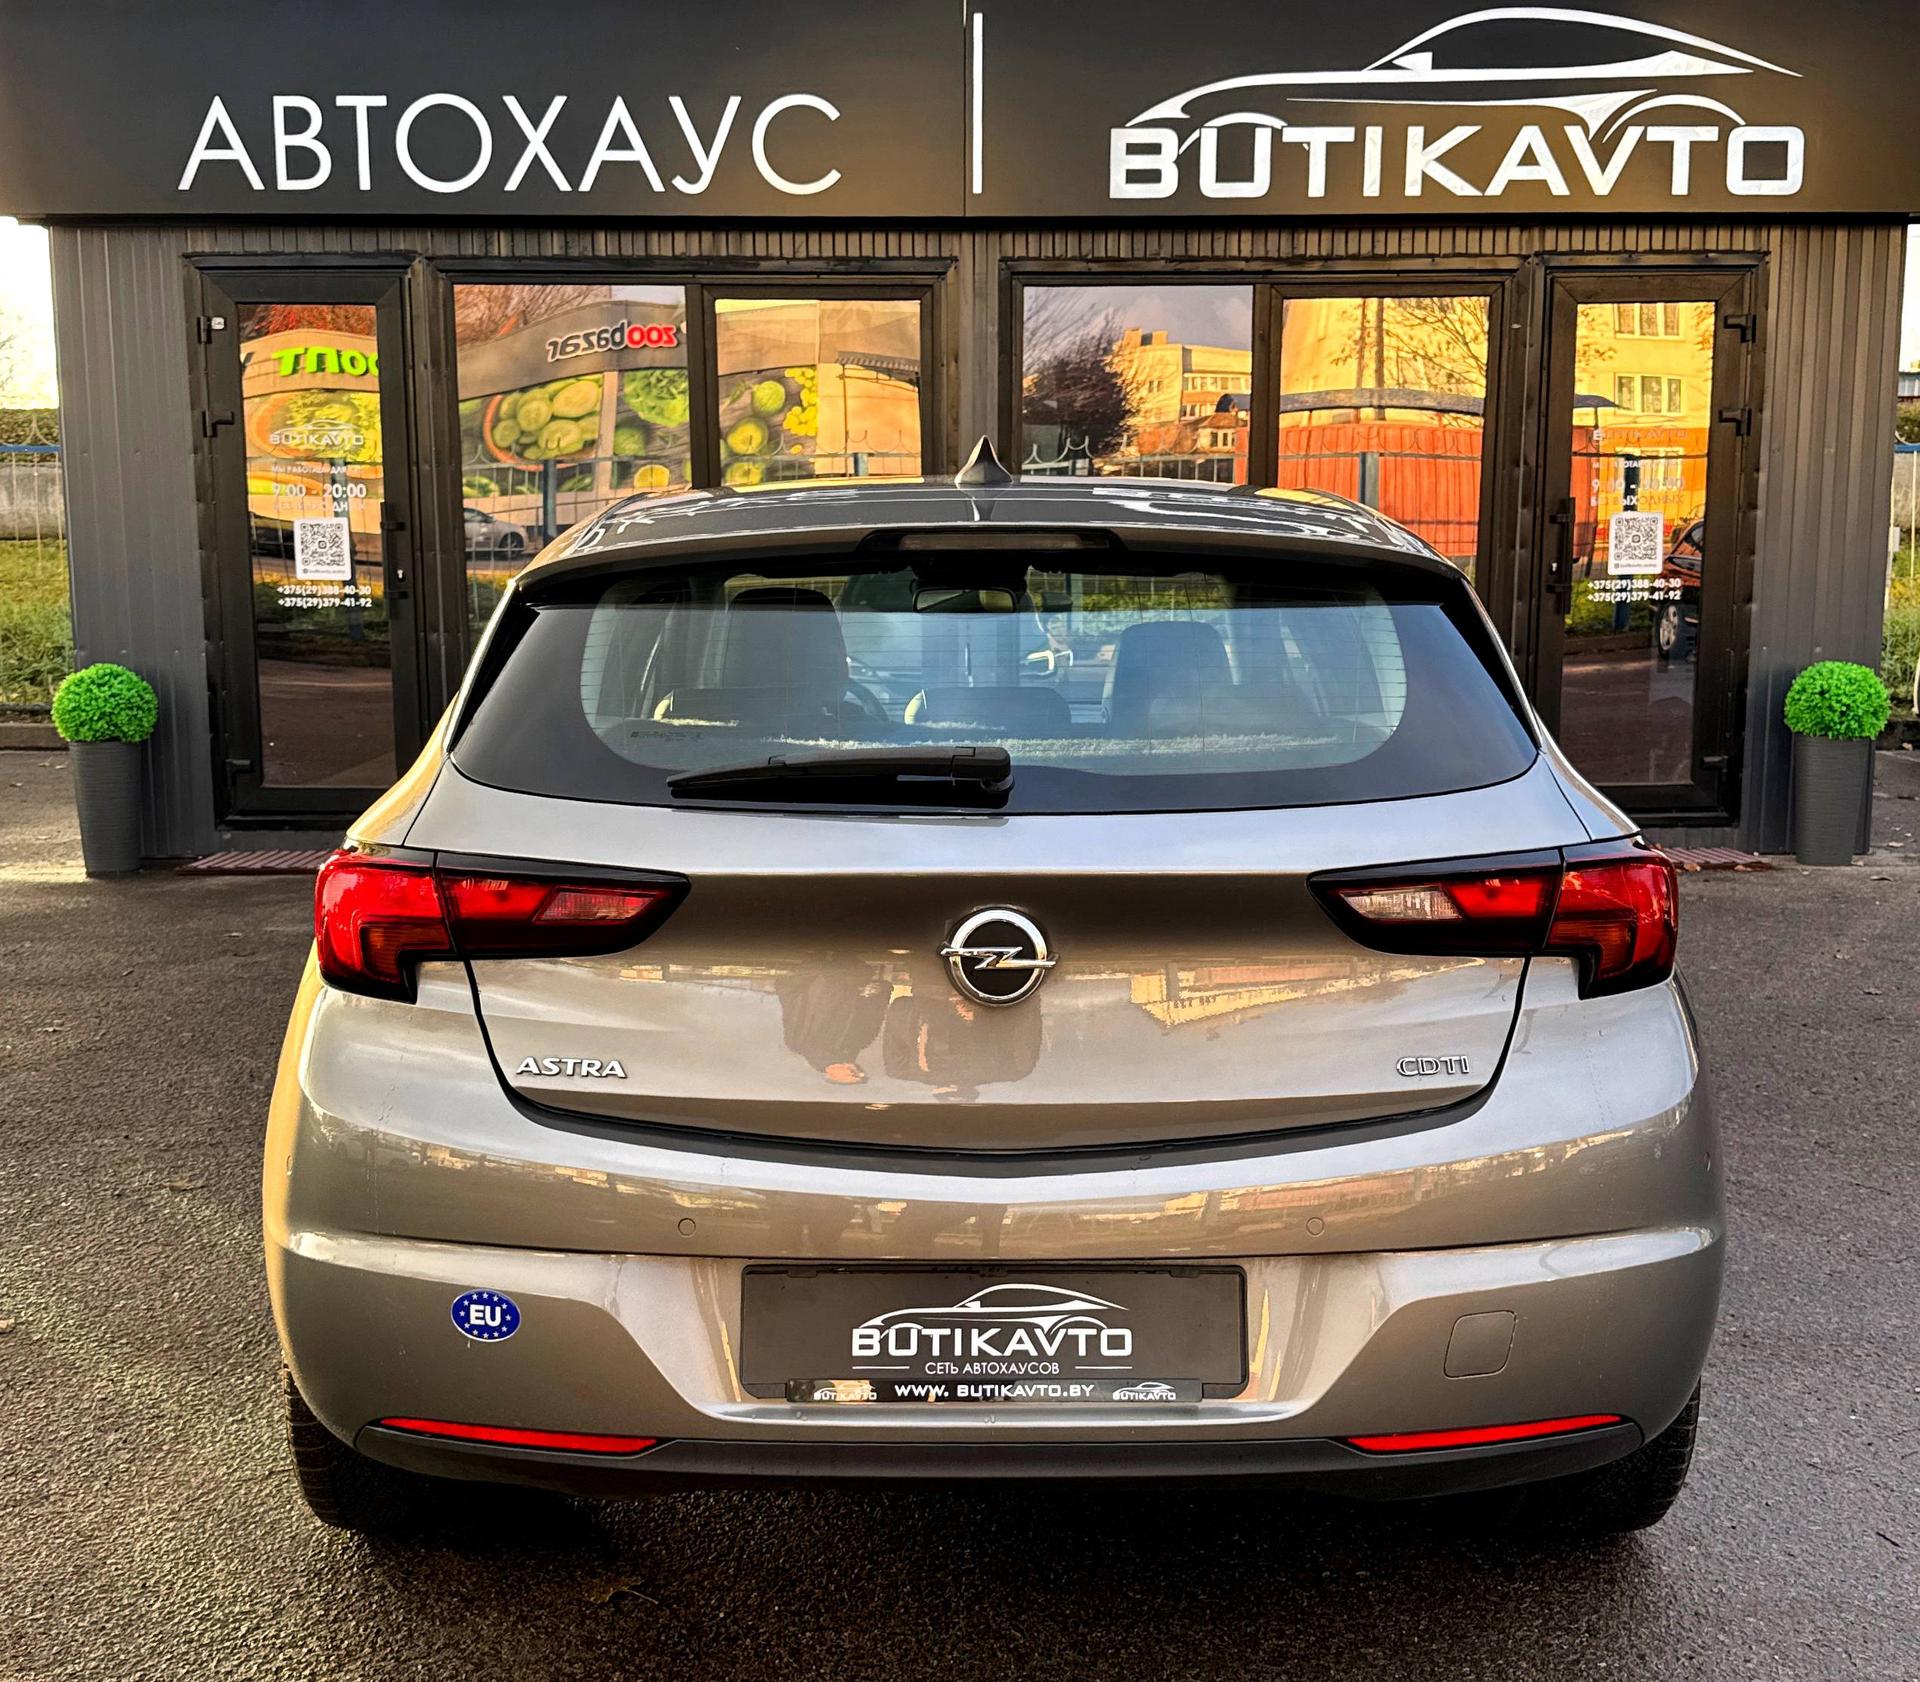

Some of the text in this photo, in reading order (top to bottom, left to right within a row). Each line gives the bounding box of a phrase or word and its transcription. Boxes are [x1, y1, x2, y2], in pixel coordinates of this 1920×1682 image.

[178, 93, 842, 195] АВТОХАУС
[1110, 126, 1804, 198] BUTIKAVTO
[323, 483, 367, 498] 20:00
[278, 597, 373, 609] +375(29)379-41-92
[1588, 591, 1682, 604] +375(29)379-41-92
[516, 1056, 627, 1078] ASTRA
[1396, 1055, 1470, 1076] CDTI
[469, 1304, 502, 1327] EU
[852, 1328, 1133, 1357] BUTIKAVTO
[925, 1362, 1060, 1375] СЕТЬ АВТОХАУСОВ
[957, 1385, 1095, 1398] BUTIKAVTO.BY
[1112, 1391, 1177, 1401] BUTIKAVTO
